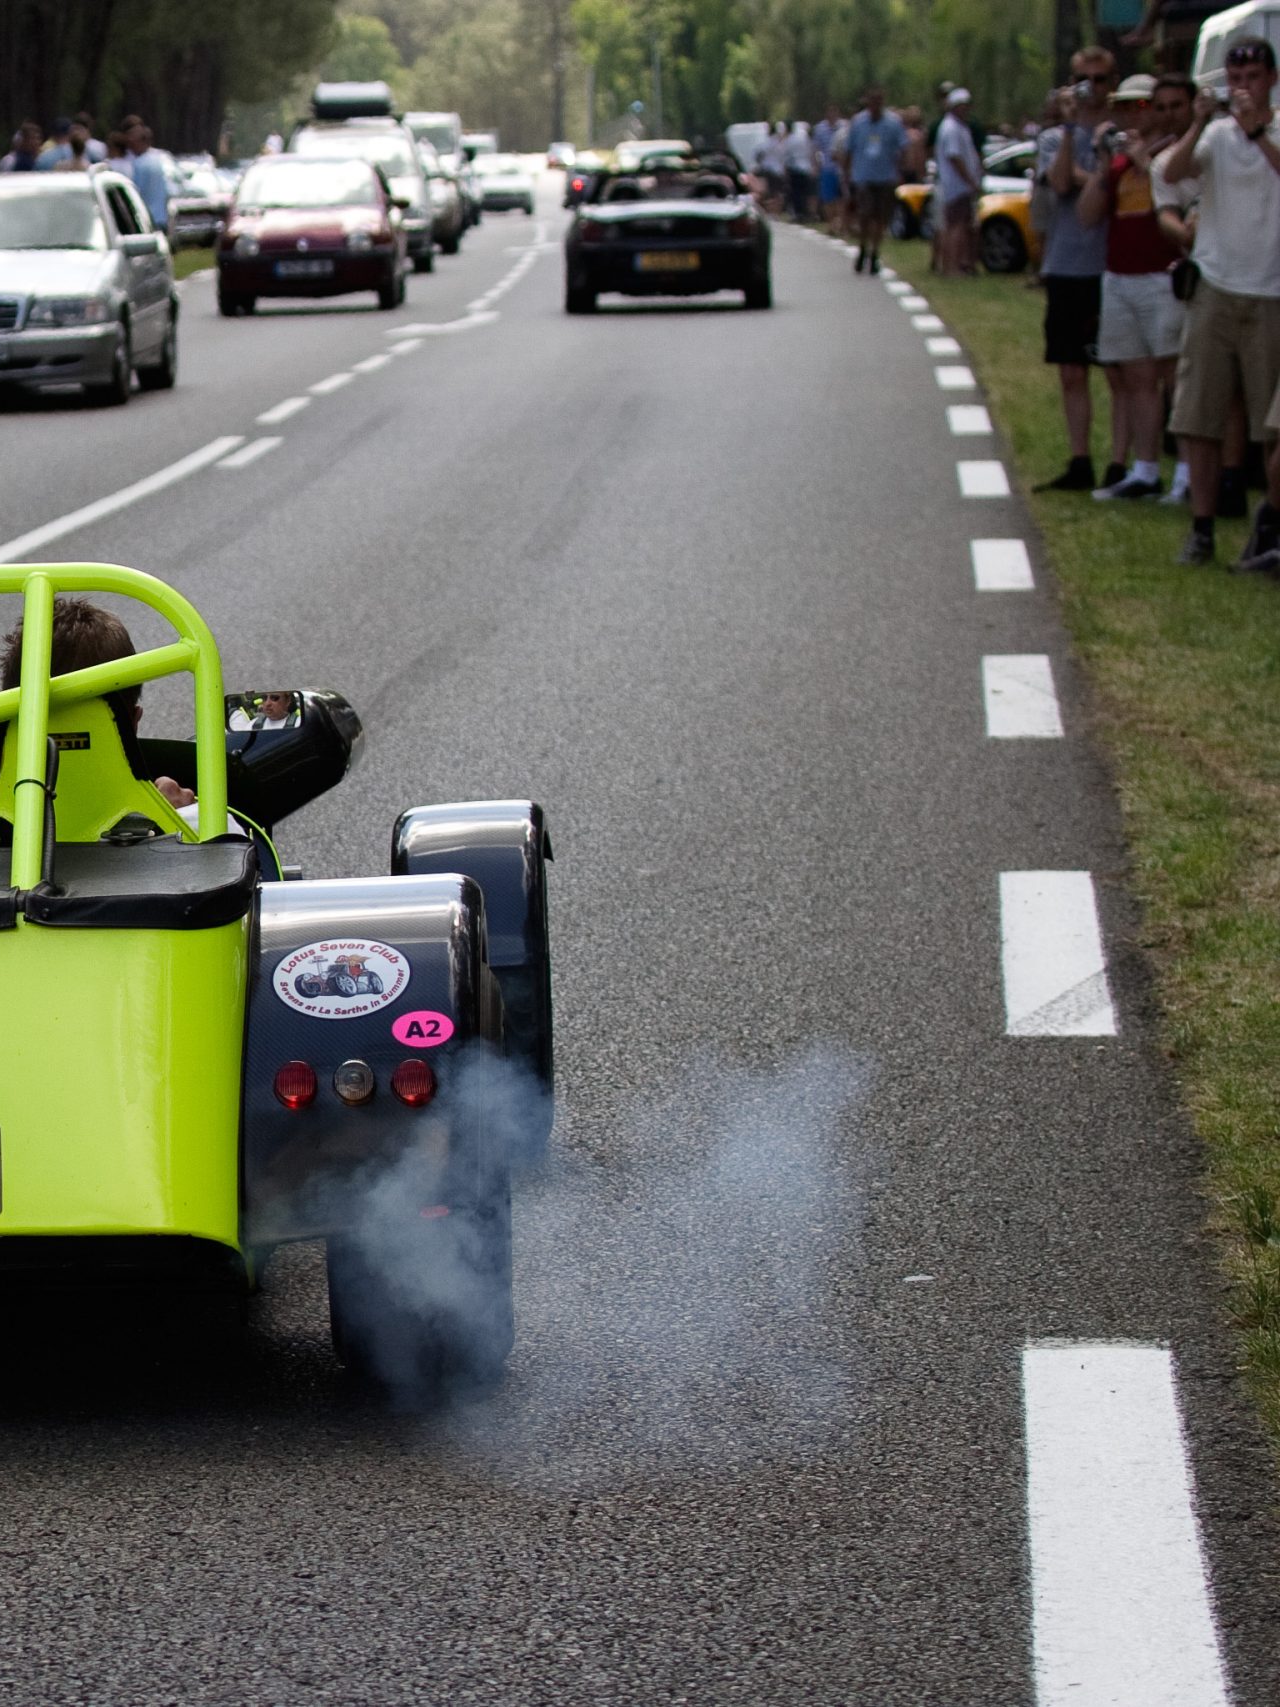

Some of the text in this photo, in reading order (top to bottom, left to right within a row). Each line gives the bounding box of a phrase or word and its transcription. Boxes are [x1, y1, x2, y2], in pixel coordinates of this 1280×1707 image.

[280, 948, 317, 975] Lotus
[319, 942, 366, 952] Seven
[369, 943, 400, 965] Club
[279, 981, 304, 1007] Sevens
[305, 1004, 317, 1013] at
[318, 1006, 331, 1015] La
[333, 1004, 369, 1016] Sarthe
[381, 968, 405, 1002] Summer
[405, 1020, 442, 1039] A2
